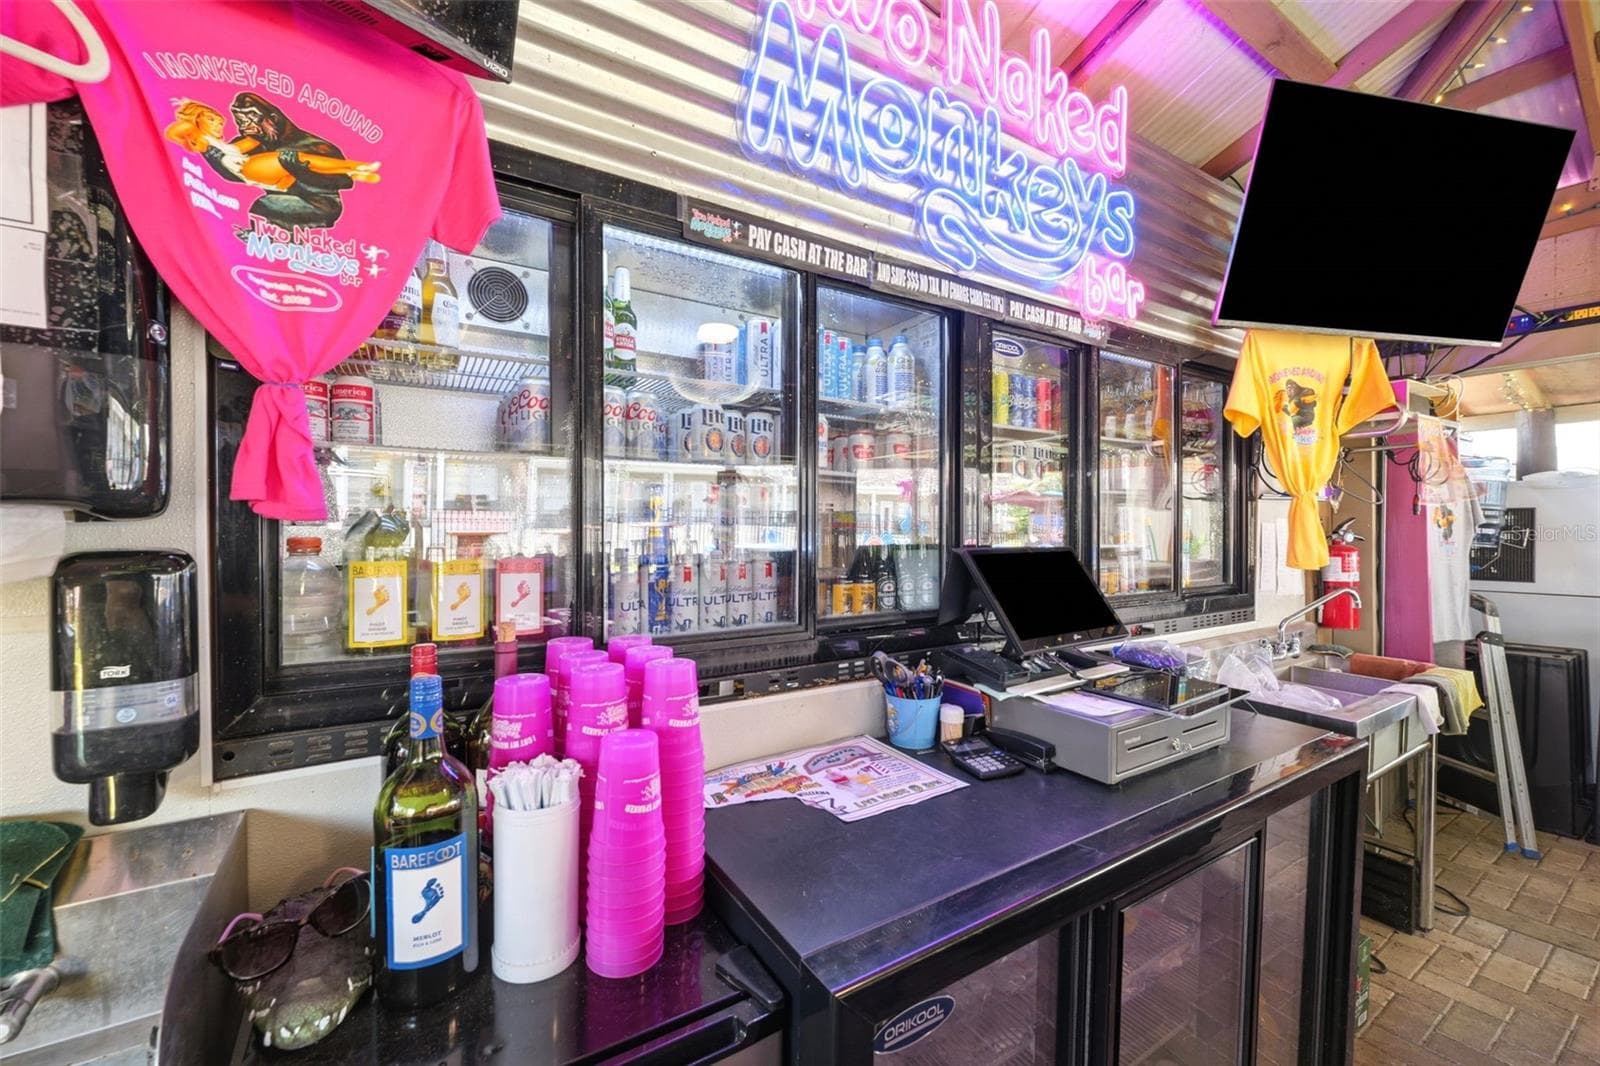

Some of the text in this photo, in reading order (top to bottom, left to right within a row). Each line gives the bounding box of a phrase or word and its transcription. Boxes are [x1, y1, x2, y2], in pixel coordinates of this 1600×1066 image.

[483, 58, 508, 77] VIZIO
[946, 0, 1128, 175] Naked
[142, 50, 384, 144] I MONKEY-ED AROUND
[746, 0, 1136, 281] Monkeys
[246, 232, 360, 277] Monkeys
[249, 213, 357, 258] Two Naked
[748, 224, 868, 278] PAY CASH AT THE BAR
[1083, 257, 1145, 320] bar
[1009, 300, 1025, 319] PAY
[1024, 304, 1046, 324] CASH
[1044, 309, 1055, 327] AT
[1055, 311, 1068, 331] THE
[1068, 316, 1082, 335] BAR
[760, 337, 769, 378] ULTRA
[391, 841, 463, 869] BAREFOOT
[412, 929, 442, 942] MERLOT
[883, 1003, 945, 1041] ORIKOOL
